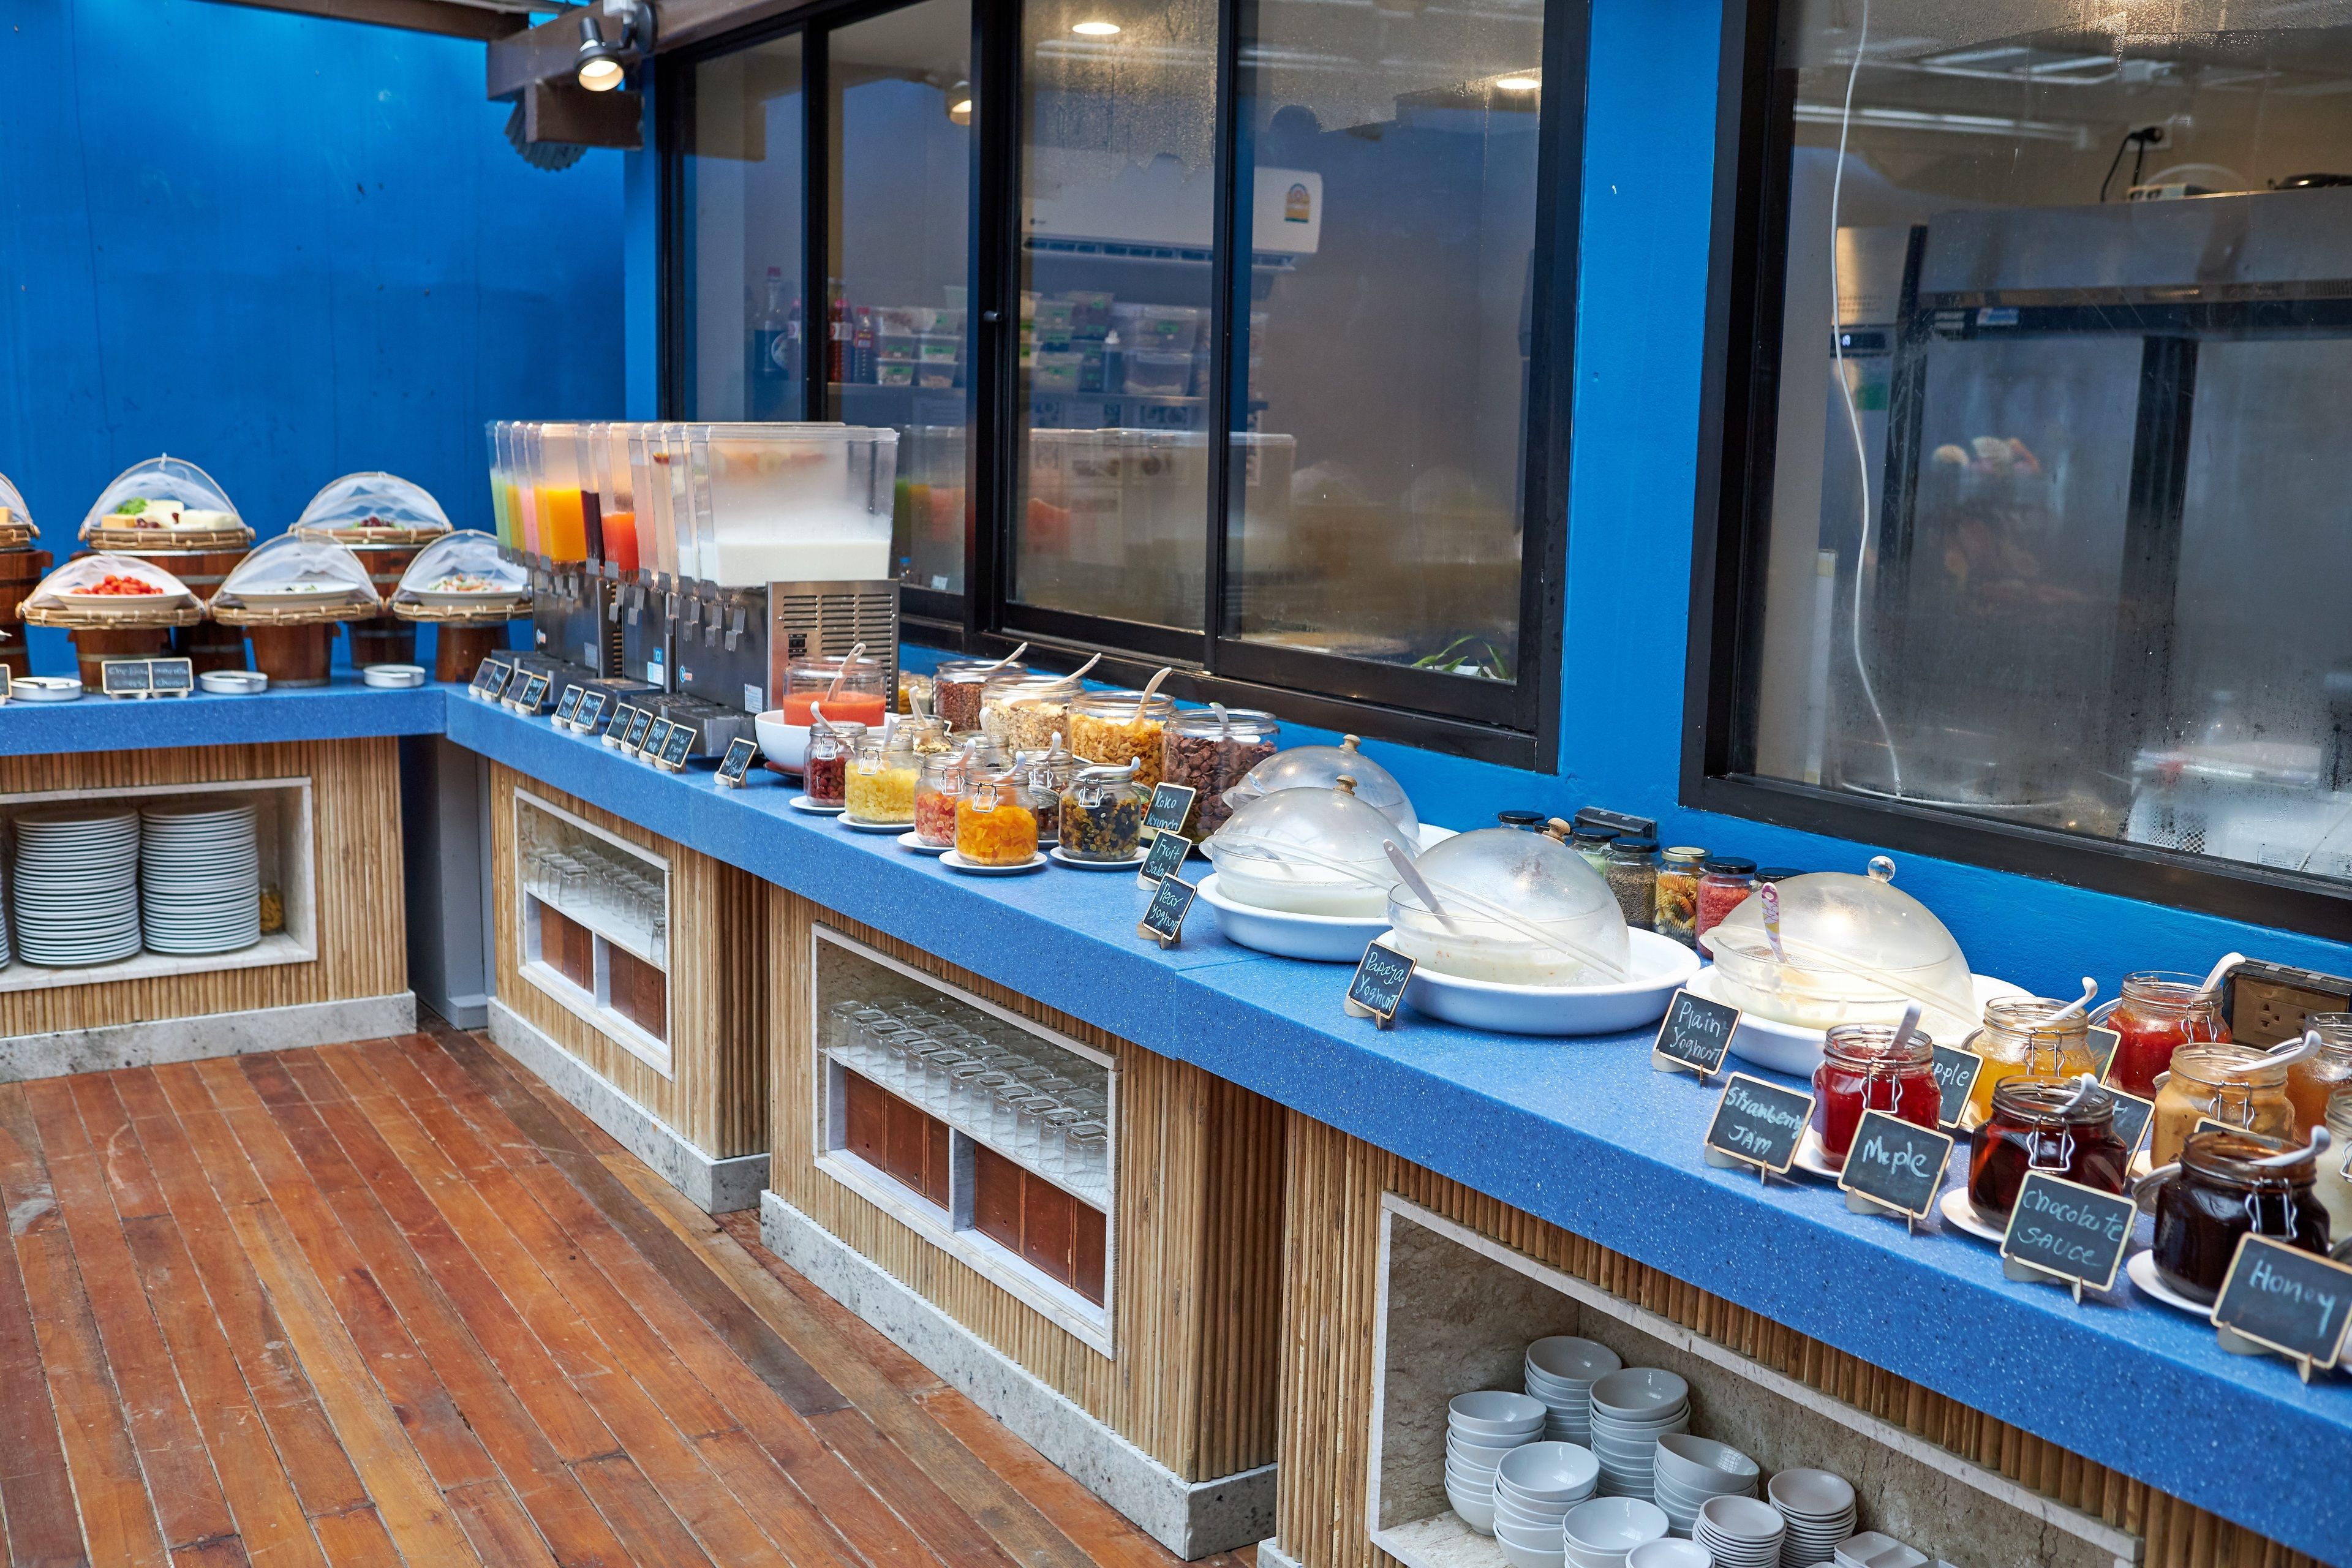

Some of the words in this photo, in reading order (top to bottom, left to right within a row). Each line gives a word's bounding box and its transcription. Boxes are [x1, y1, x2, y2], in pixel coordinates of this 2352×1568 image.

[1157, 838, 1180, 861] Fruit
[1365, 951, 1404, 985] Papaya
[1678, 1001, 1721, 1038] Plain
[2248, 1259, 2336, 1339] Honey
